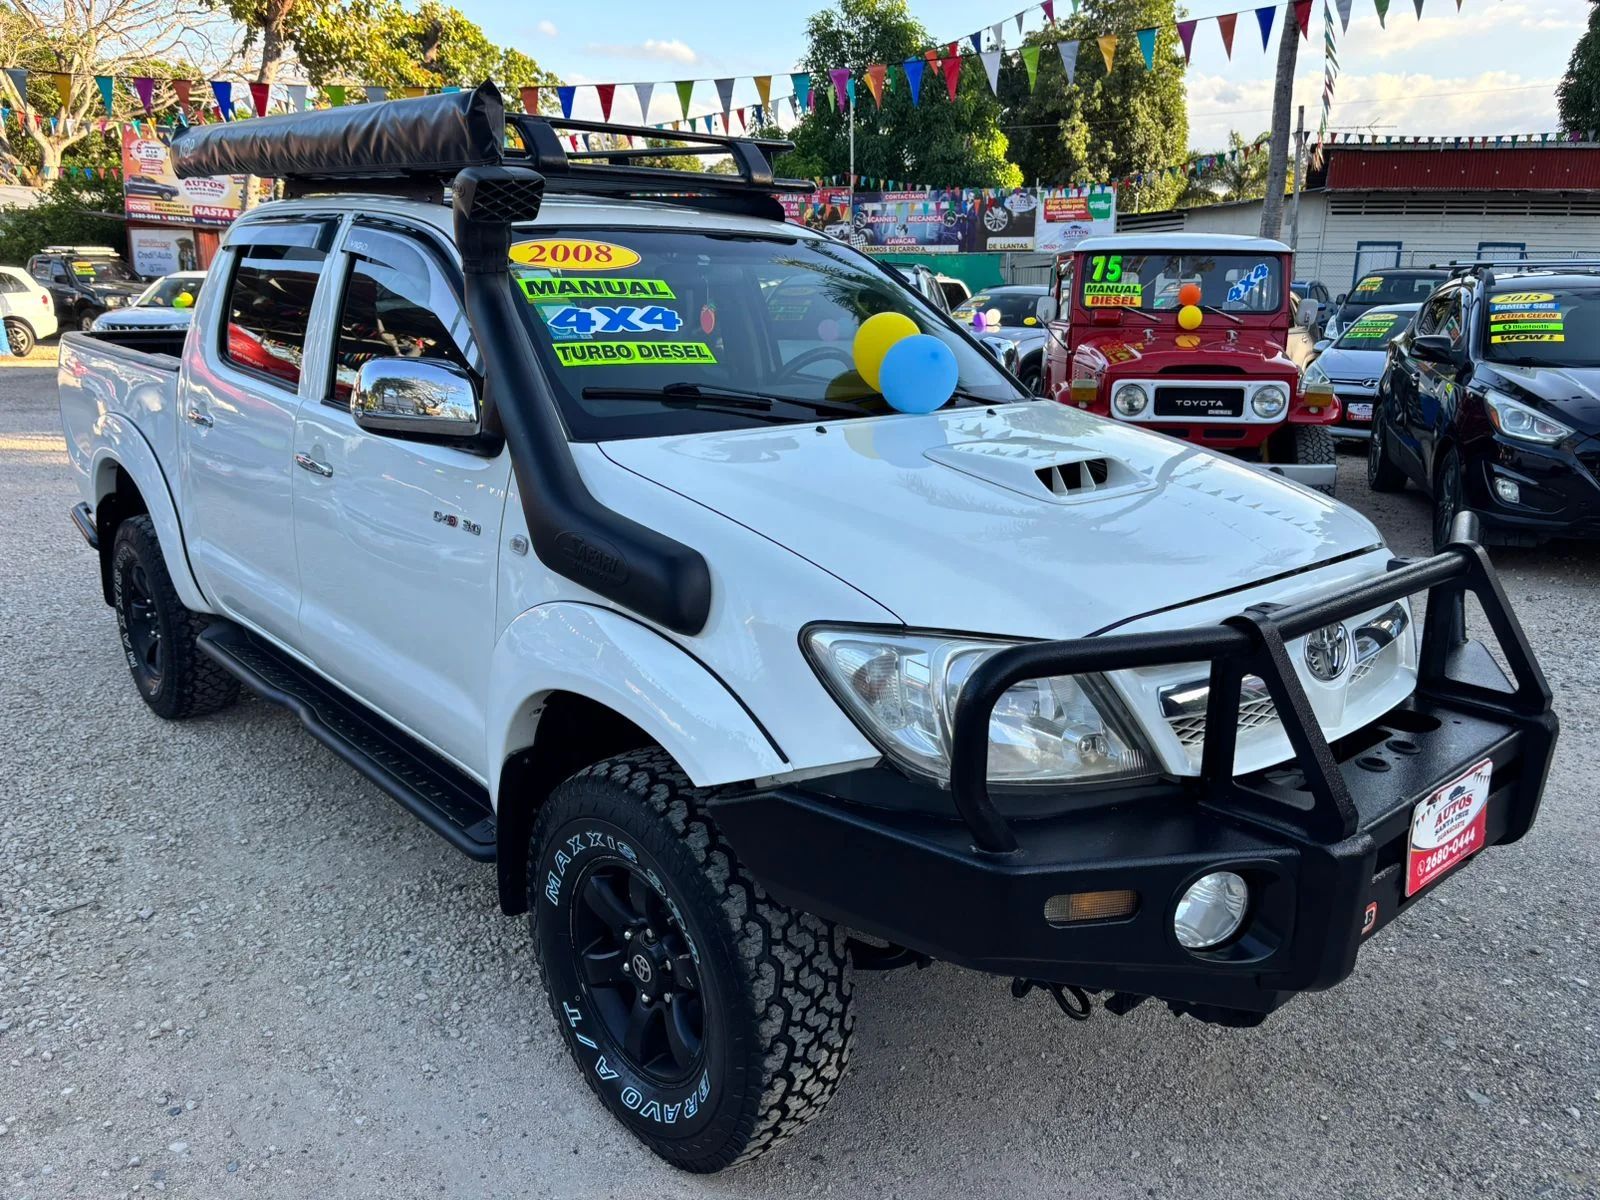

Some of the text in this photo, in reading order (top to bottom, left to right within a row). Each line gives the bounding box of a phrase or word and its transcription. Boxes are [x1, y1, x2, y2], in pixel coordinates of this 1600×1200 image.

[184, 179, 225, 190] AUTOS
[194, 206, 232, 219] HASTA
[528, 244, 613, 263] 2008
[1092, 255, 1122, 282] 75
[525, 280, 670, 297] MANUAL
[1085, 283, 1141, 294] MANUAL
[1090, 295, 1137, 305] DIESEL
[1500, 294, 1541, 302] 2015
[557, 344, 711, 361] TURBO DIESEL
[1175, 399, 1224, 407] TOYOTA
[1434, 793, 1474, 829] AUTOS
[1434, 808, 1470, 836] SANTA CRUZ
[1425, 826, 1476, 873] 2680-0444
[544, 831, 639, 907] MAXXIS
[620, 1067, 712, 1124] BRAVO
